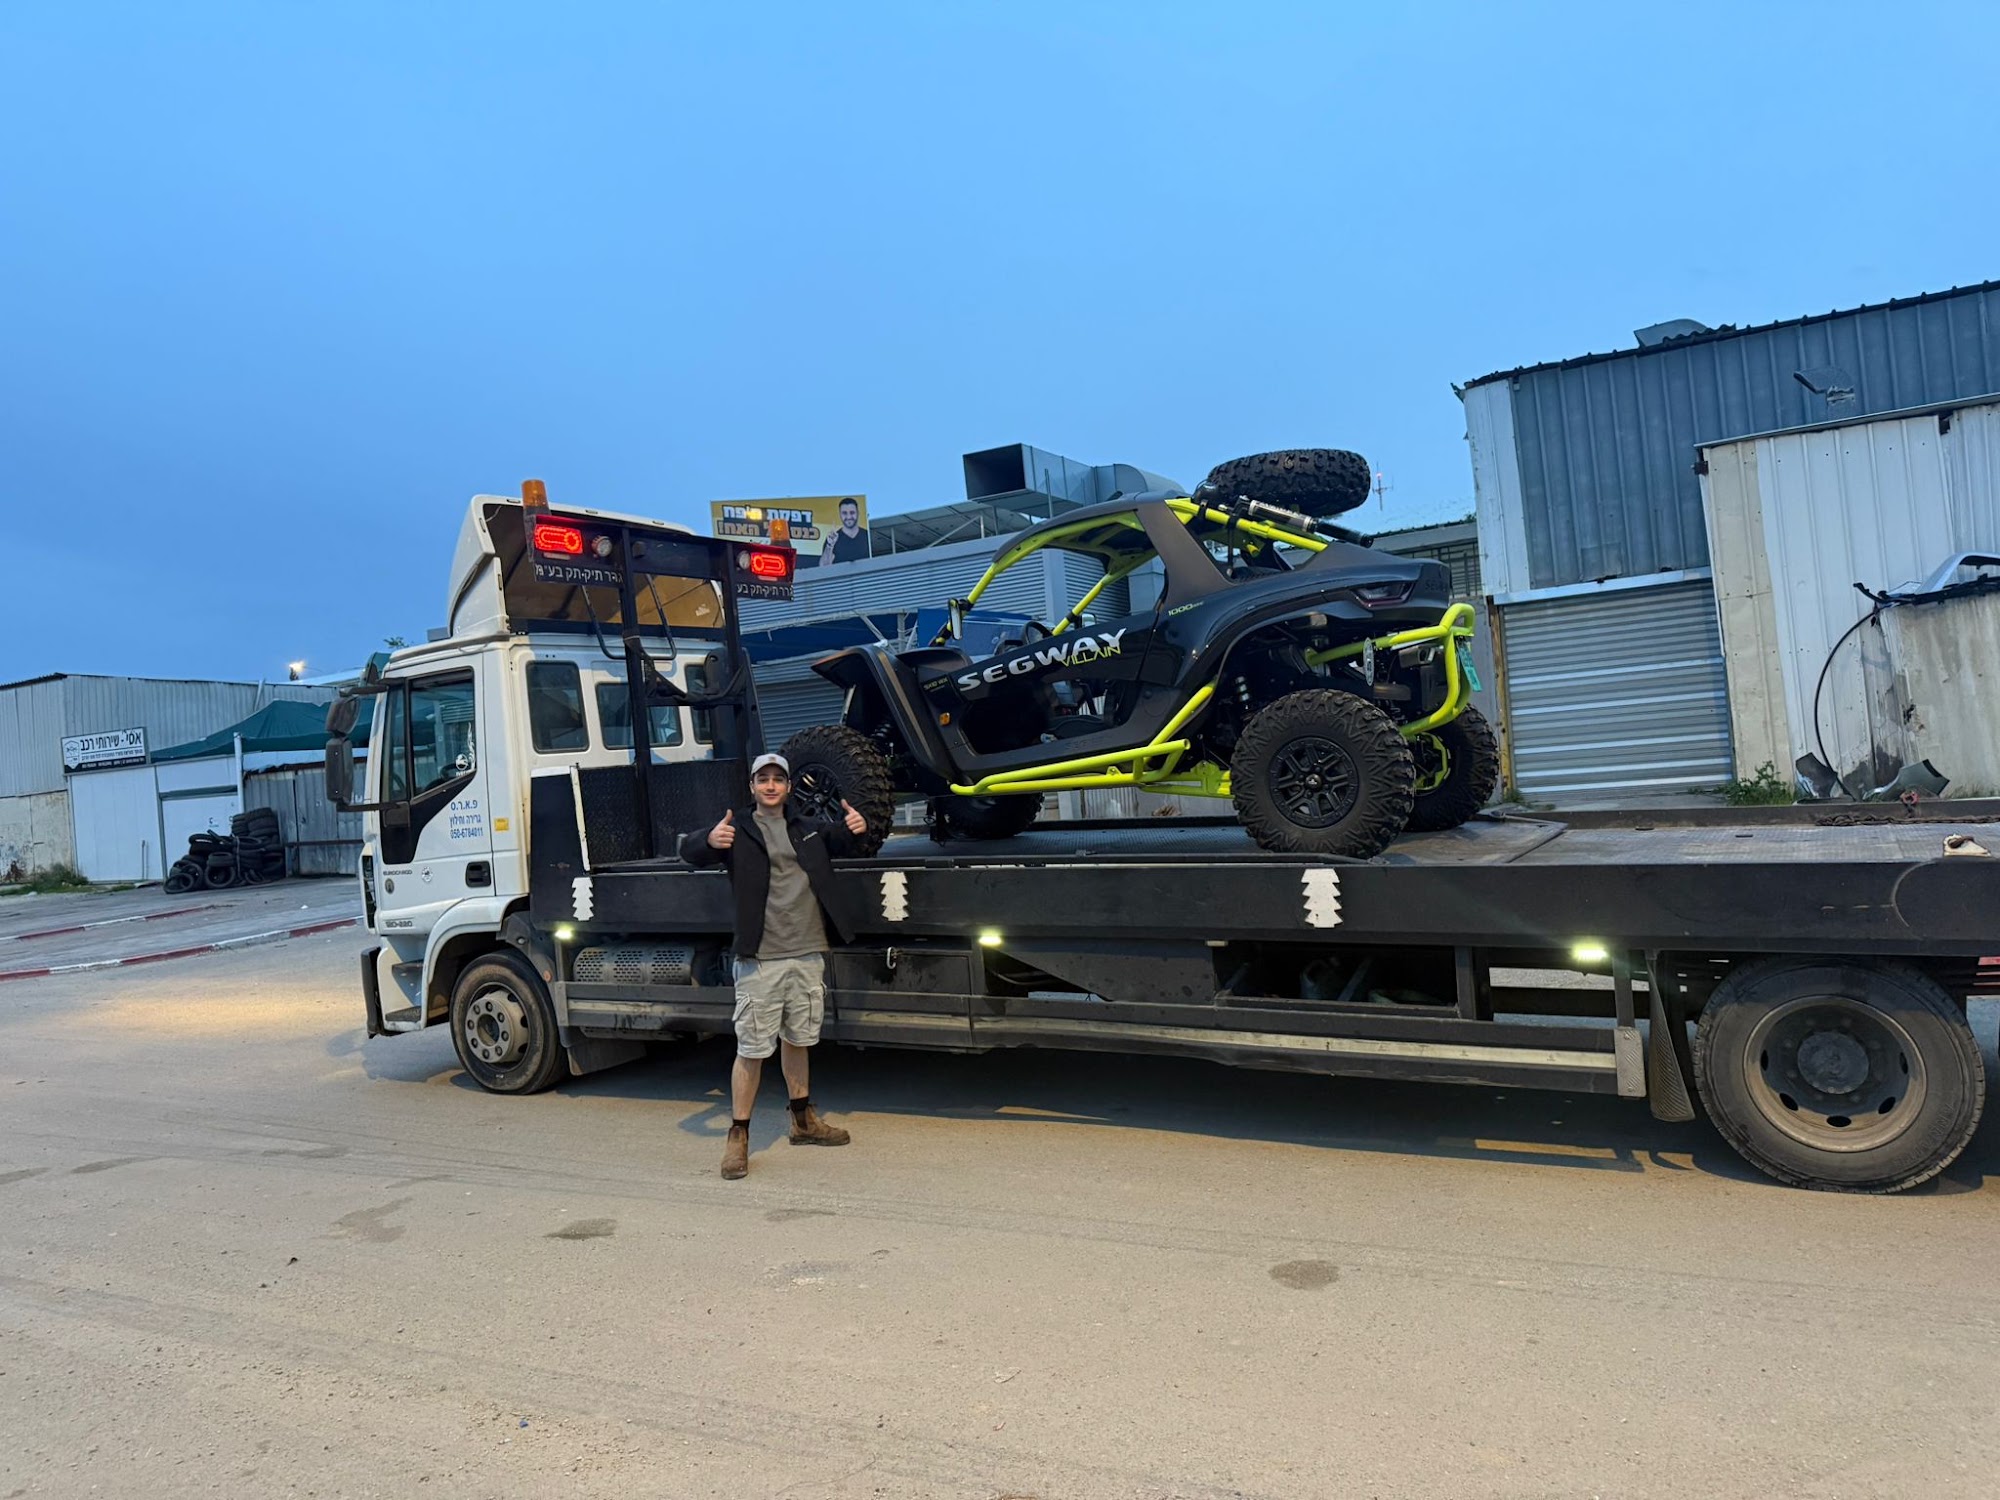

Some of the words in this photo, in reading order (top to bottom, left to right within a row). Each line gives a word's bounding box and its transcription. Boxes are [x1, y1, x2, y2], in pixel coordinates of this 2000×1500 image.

[957, 627, 1127, 692] SEGWAY
[1060, 645, 1122, 667] VILLAIN
[80, 737, 95, 751] רכב
[95, 734, 120, 750] שירותי
